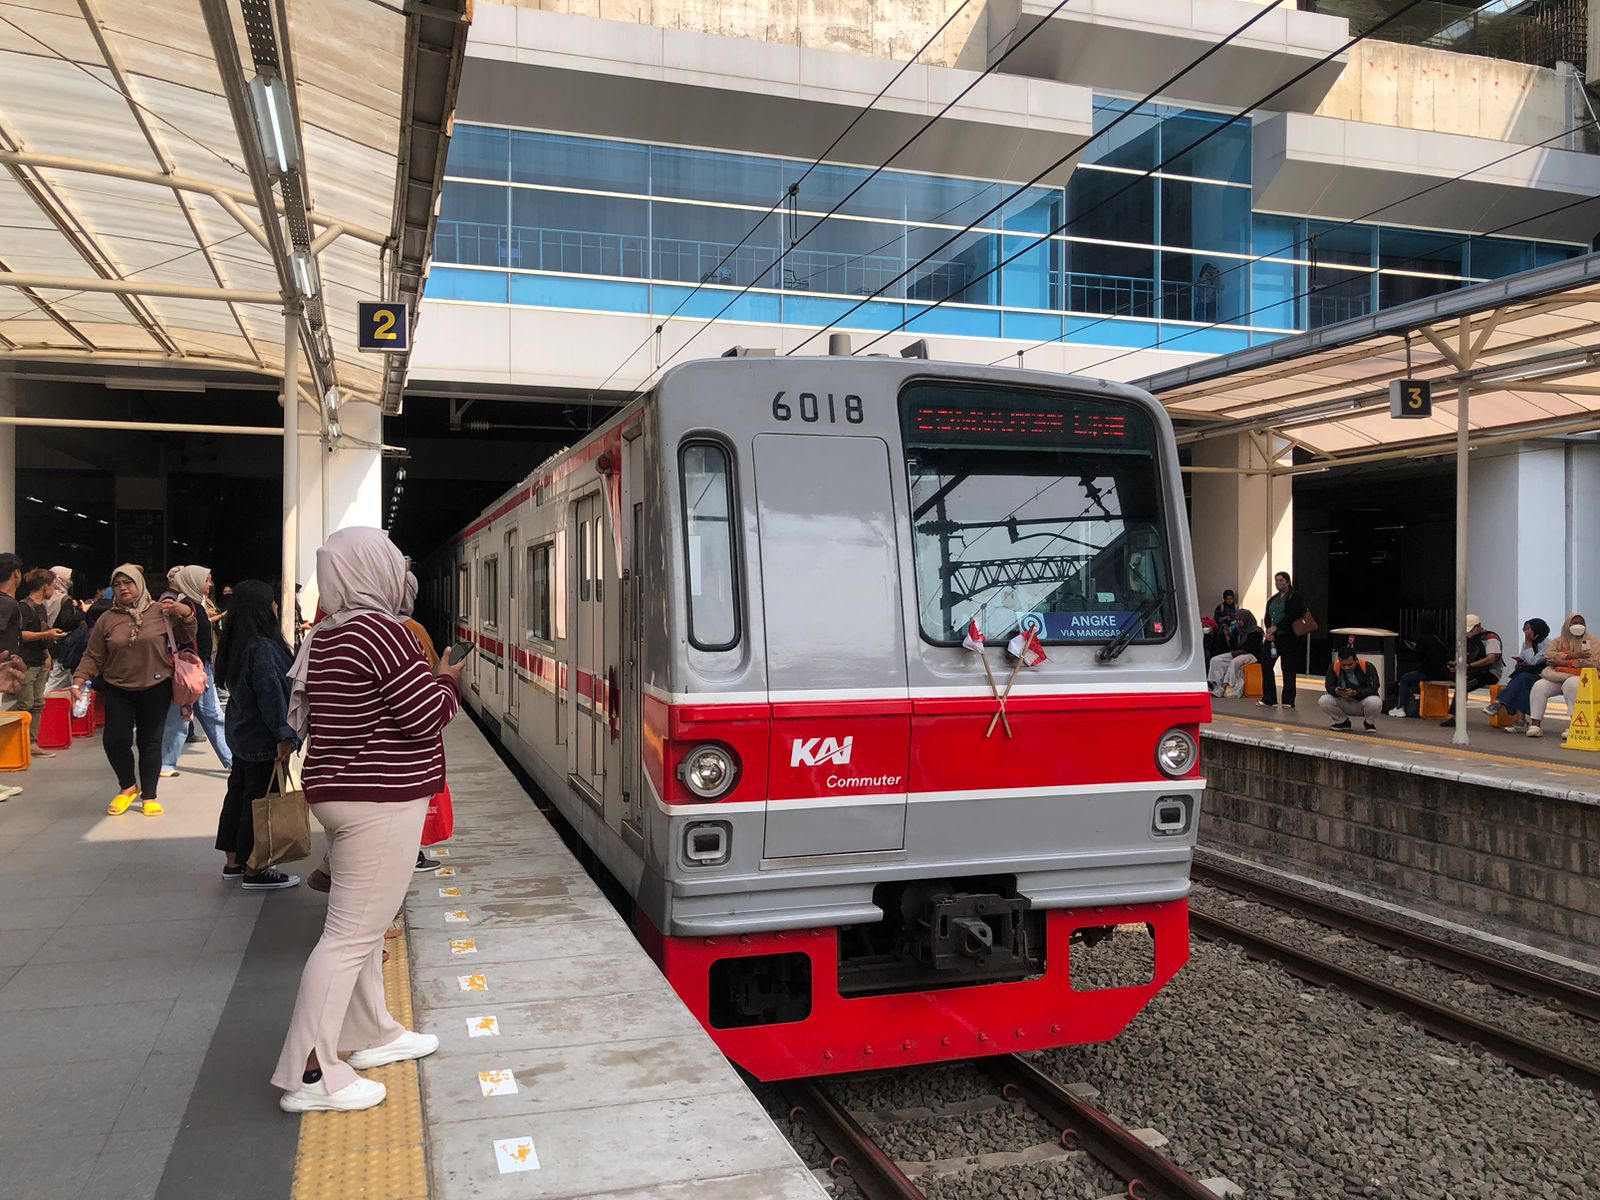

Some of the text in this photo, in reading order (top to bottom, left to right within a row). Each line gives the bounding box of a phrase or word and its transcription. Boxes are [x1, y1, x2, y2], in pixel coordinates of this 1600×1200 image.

[373, 309, 397, 339] 2
[772, 391, 864, 424] 6018
[1408, 387, 1423, 409] 3
[1071, 615, 1117, 627] ANGKE
[1060, 629, 1130, 638] VIA MANGGAR
[790, 735, 854, 768] KAI
[826, 774, 902, 788] Commuter
